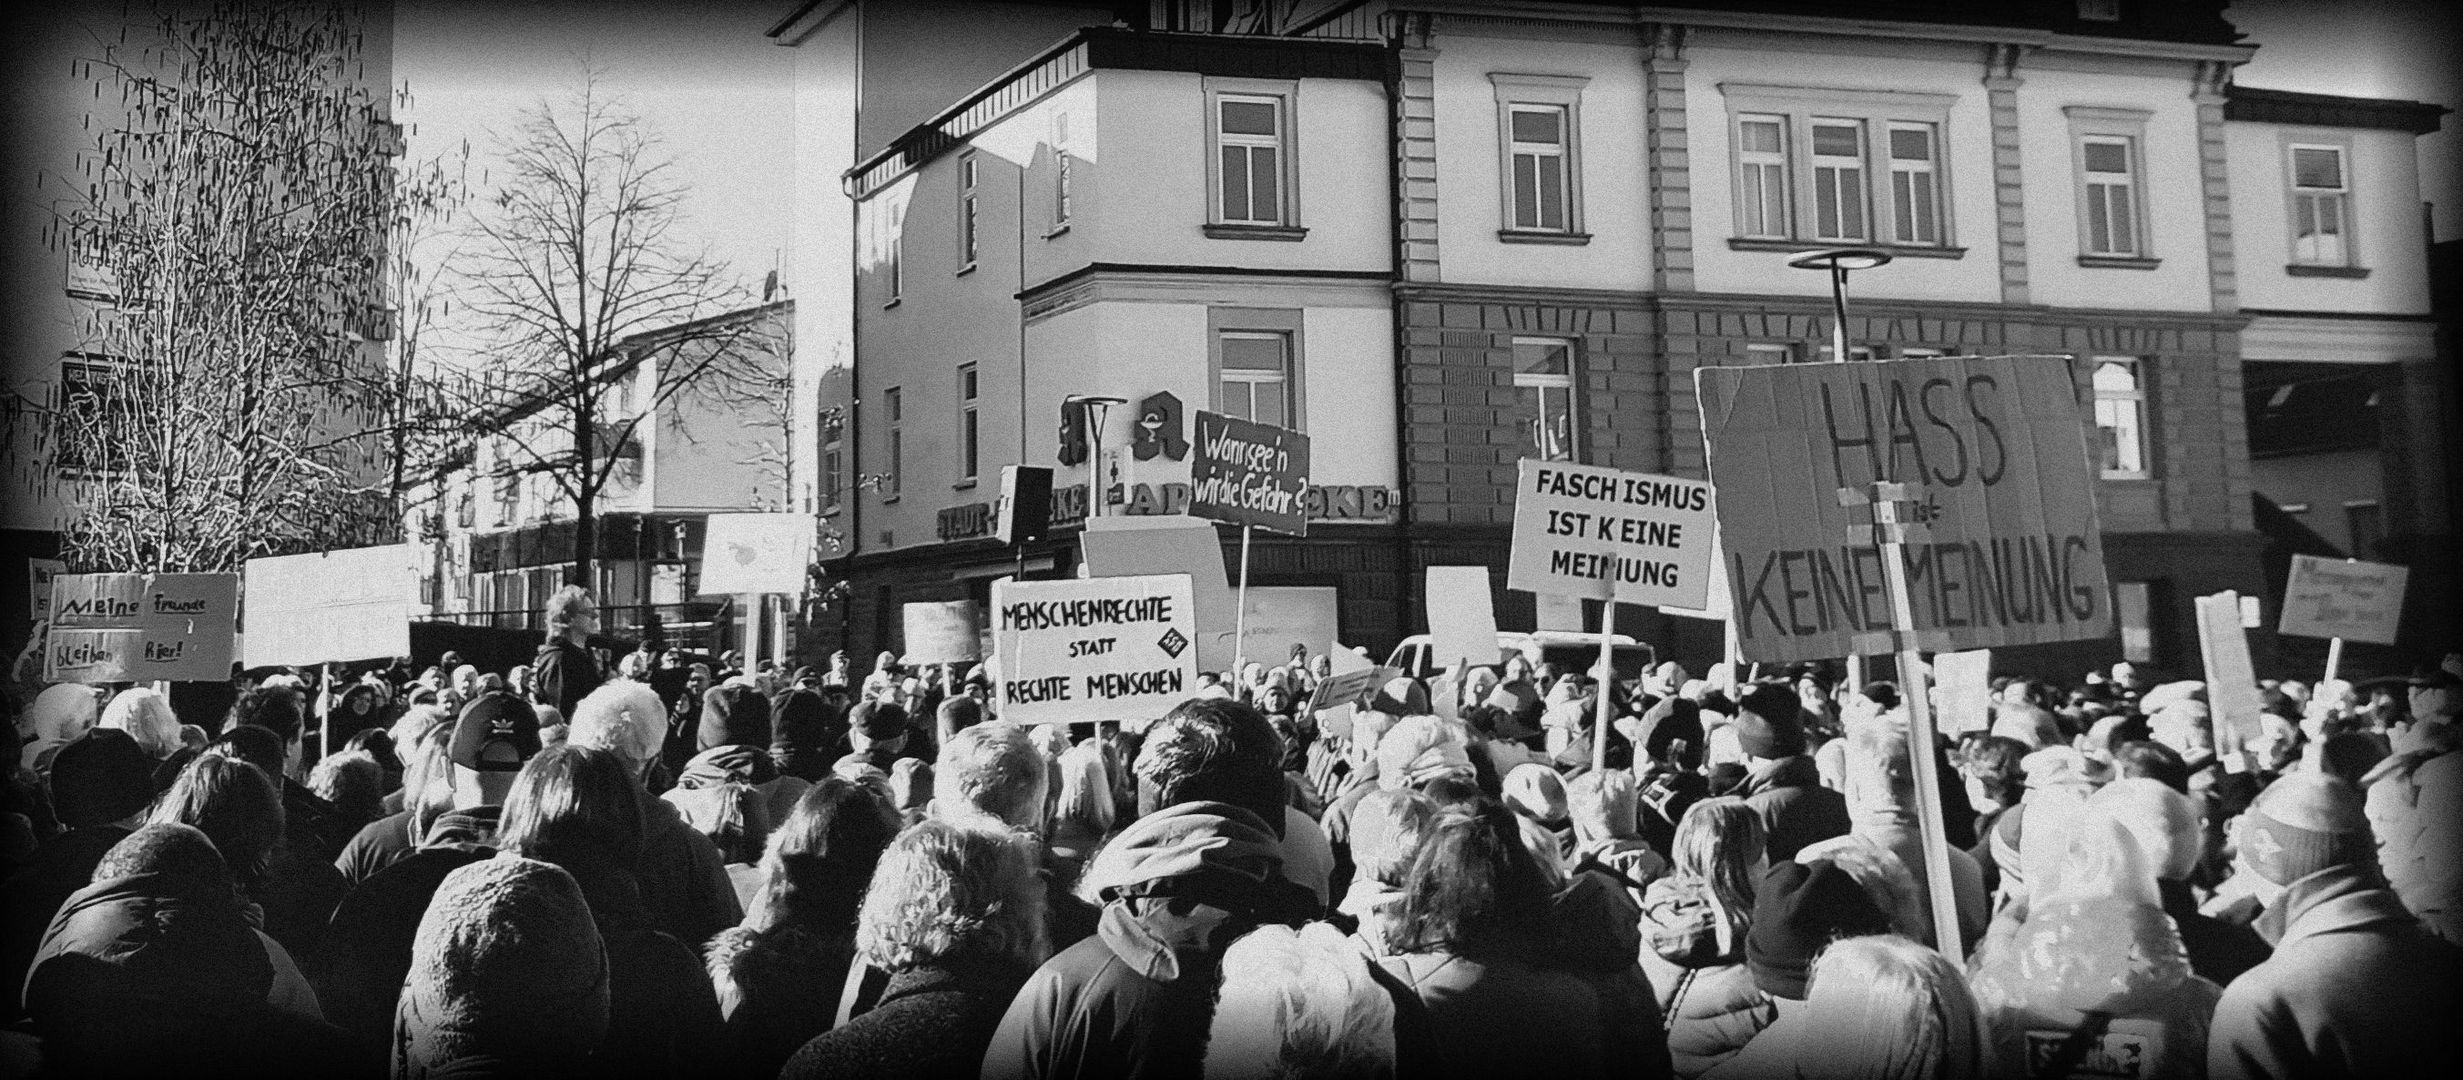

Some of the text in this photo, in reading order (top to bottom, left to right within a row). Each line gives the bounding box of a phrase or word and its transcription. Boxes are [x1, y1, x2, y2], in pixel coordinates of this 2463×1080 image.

[1822, 375, 2006, 487] HASS
[1547, 510, 1591, 538] IST
[1912, 494, 1940, 528] ist
[1551, 550, 1679, 588] MEINUNG
[1735, 535, 2094, 640] KEINE MEINUNG
[1002, 596, 1172, 631] MENSCHENRECHTE
[1069, 637, 1116, 658] STATT
[1006, 667, 1183, 705] RECHTE MENSCHEN
